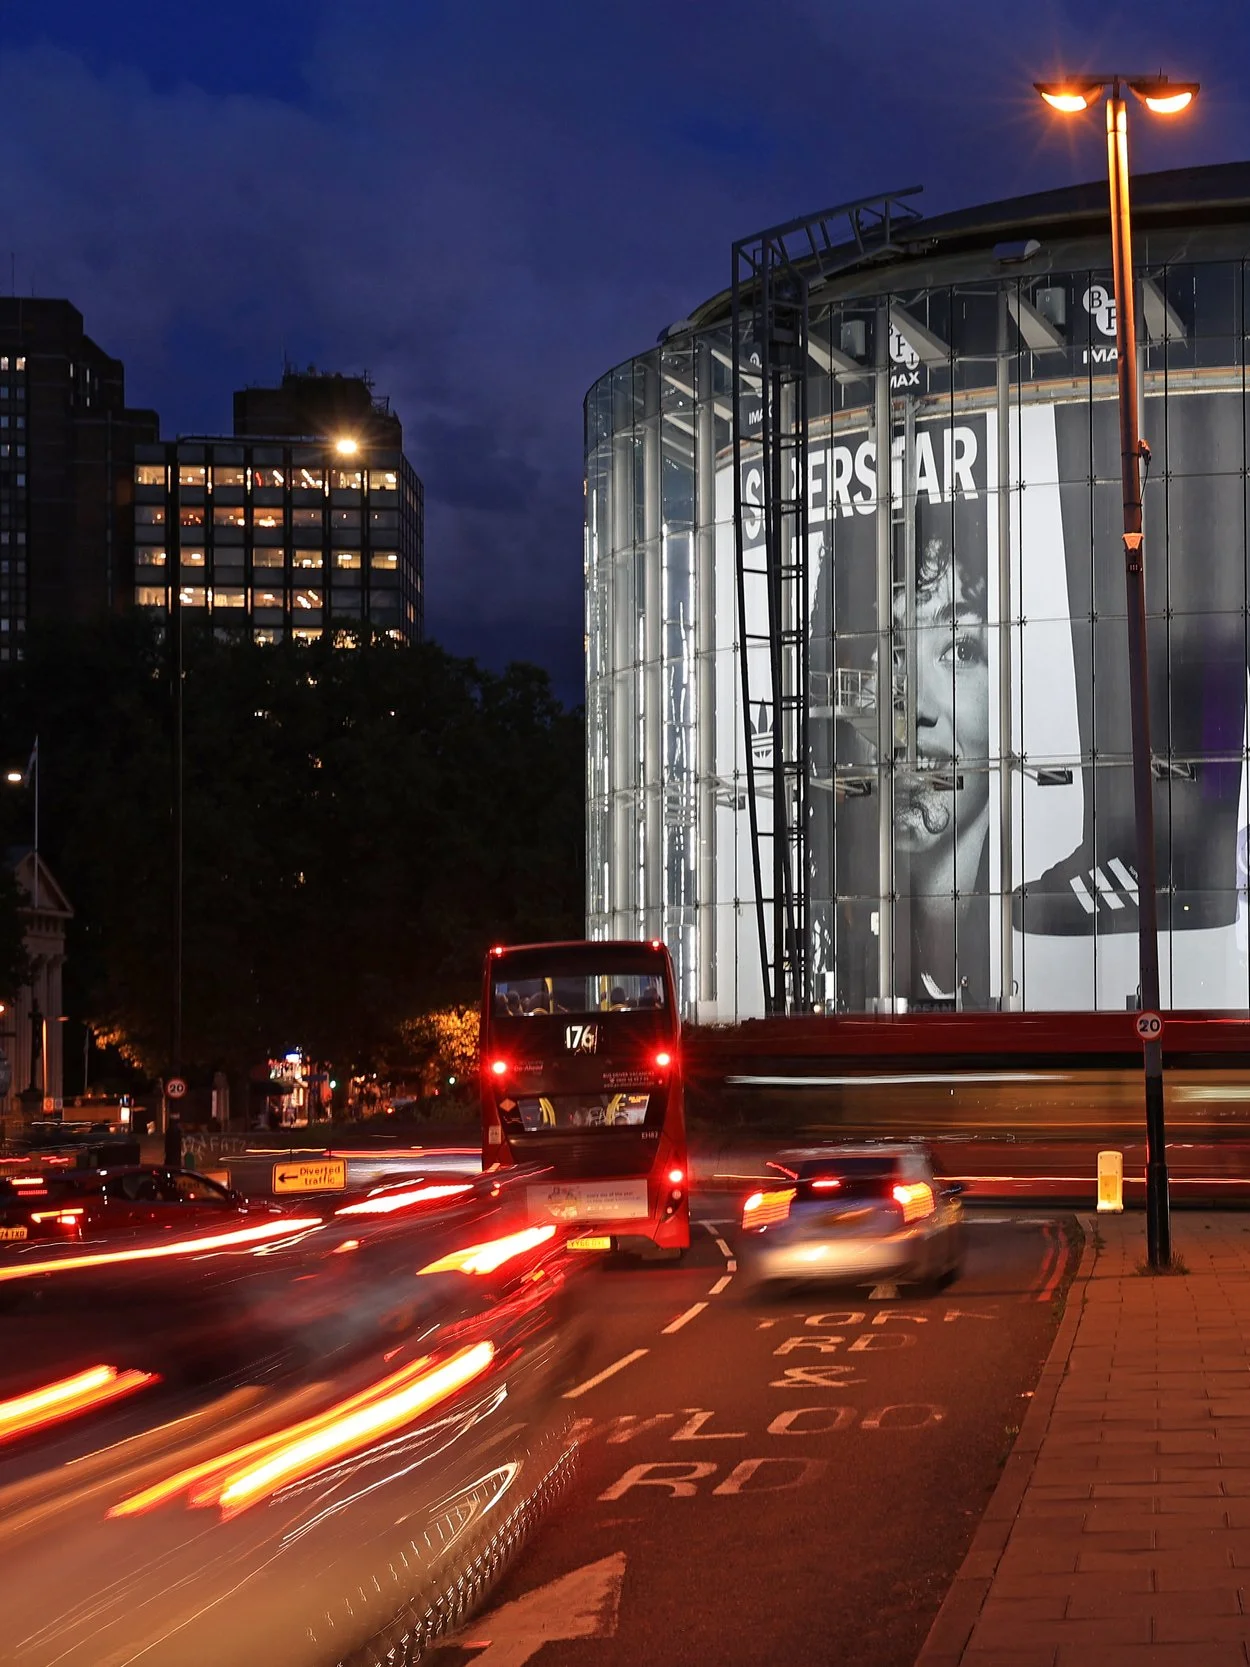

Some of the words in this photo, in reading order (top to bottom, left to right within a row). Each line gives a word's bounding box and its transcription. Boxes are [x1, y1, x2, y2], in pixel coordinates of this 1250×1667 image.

[1082, 348, 1119, 364] IMA
[1139, 1019, 1160, 1032] 20
[566, 1025, 595, 1049] 176
[169, 1084, 184, 1093] 20
[300, 1166, 340, 1175] Diverted
[305, 1174, 335, 1186] traffic
[773, 1334, 917, 1355] RD
[768, 1366, 868, 1387] &
[597, 1457, 826, 1501] RD
